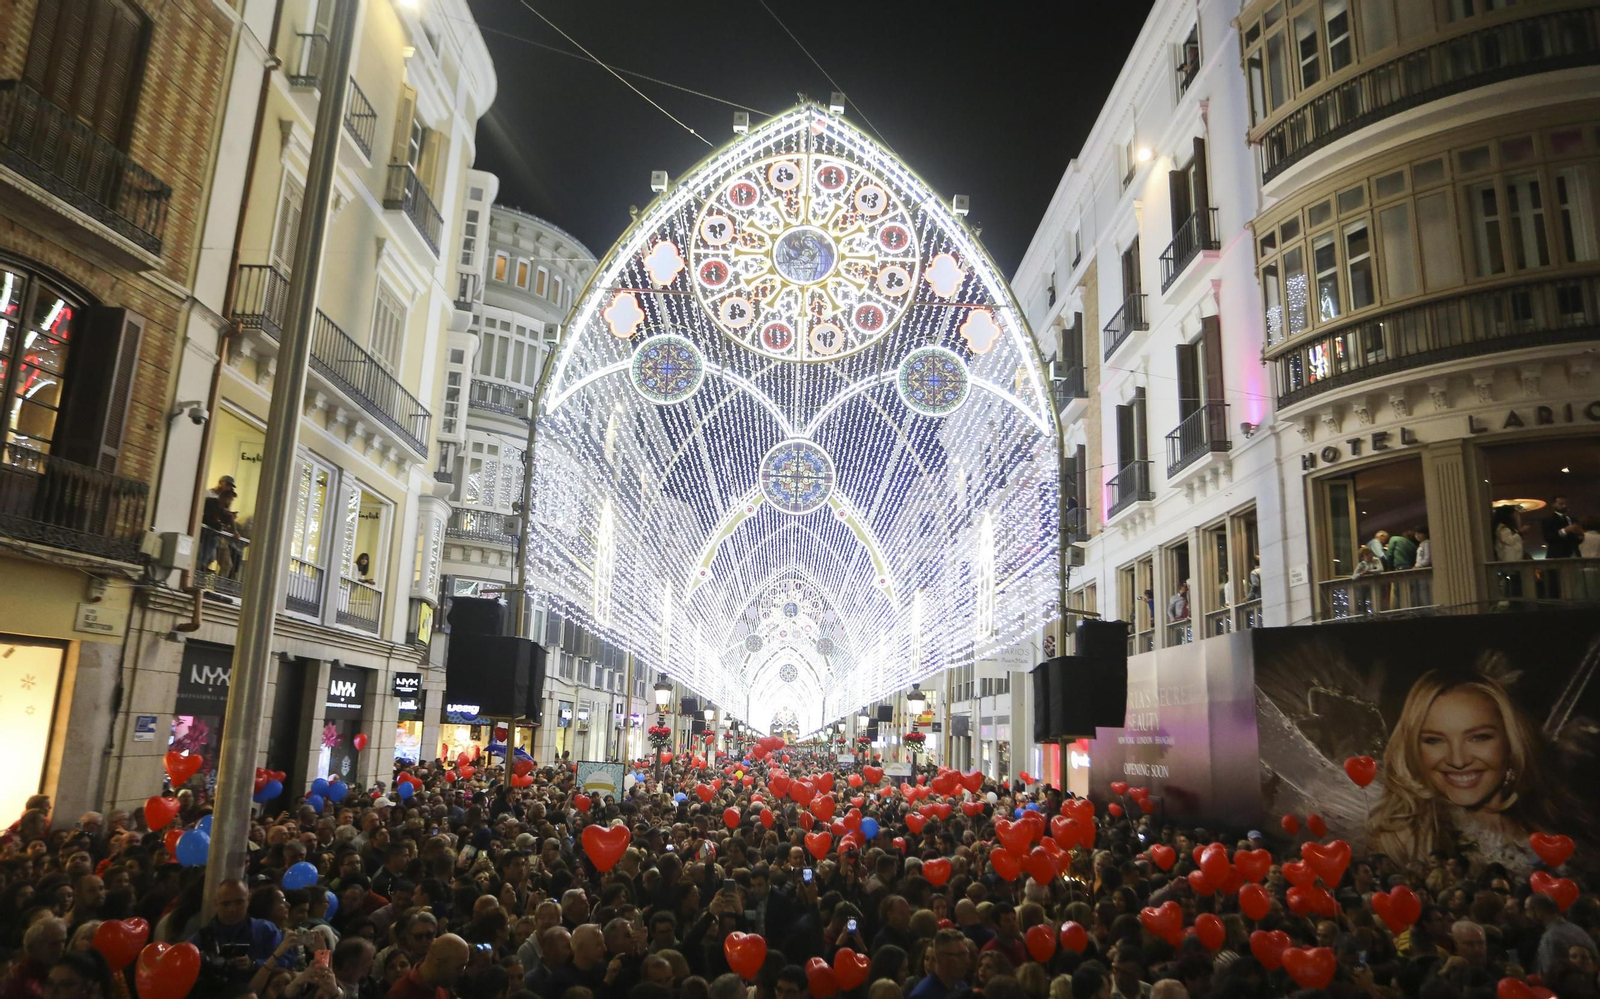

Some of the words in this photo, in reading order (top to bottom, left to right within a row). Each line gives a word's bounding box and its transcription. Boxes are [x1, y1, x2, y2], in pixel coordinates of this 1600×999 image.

[1301, 427, 1418, 471] HOTEL
[1467, 400, 1600, 434] LARIO
[241, 452, 263, 463] Engli
[190, 664, 232, 687] NYX
[396, 677, 419, 687] NYX
[330, 680, 357, 698] NYX
[1127, 712, 1160, 732] BEAUTY
[1123, 762, 1150, 777] OPENING
[1150, 764, 1170, 778] SOON
